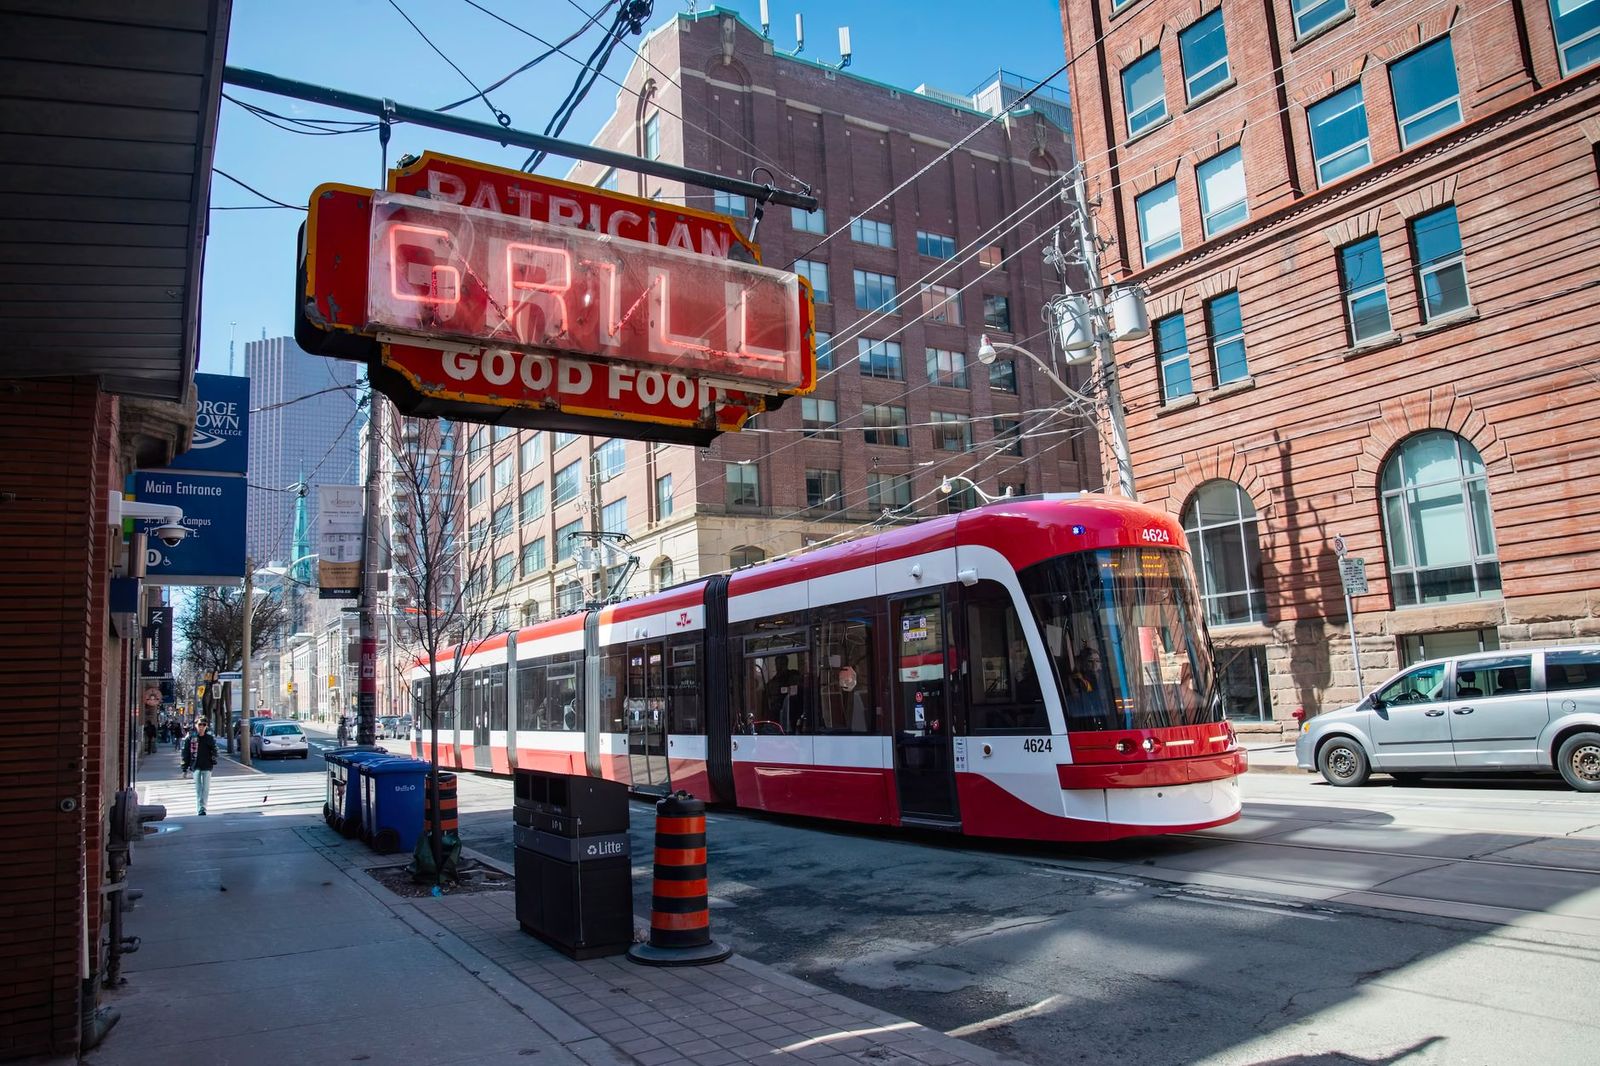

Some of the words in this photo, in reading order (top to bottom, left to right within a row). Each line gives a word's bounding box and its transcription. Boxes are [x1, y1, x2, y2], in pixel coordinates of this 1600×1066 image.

[427, 169, 731, 259] PATRICIAN
[386, 216, 785, 371] GRILL
[442, 348, 593, 395] GOOD
[608, 361, 727, 411] FOOD
[208, 428, 242, 436] COLLEGE
[145, 480, 172, 494] Main
[176, 481, 222, 496] Entrance
[182, 515, 212, 527] Campus
[1142, 528, 1169, 542] 4624
[1023, 738, 1052, 753] 4624
[598, 841, 624, 855] Litte
